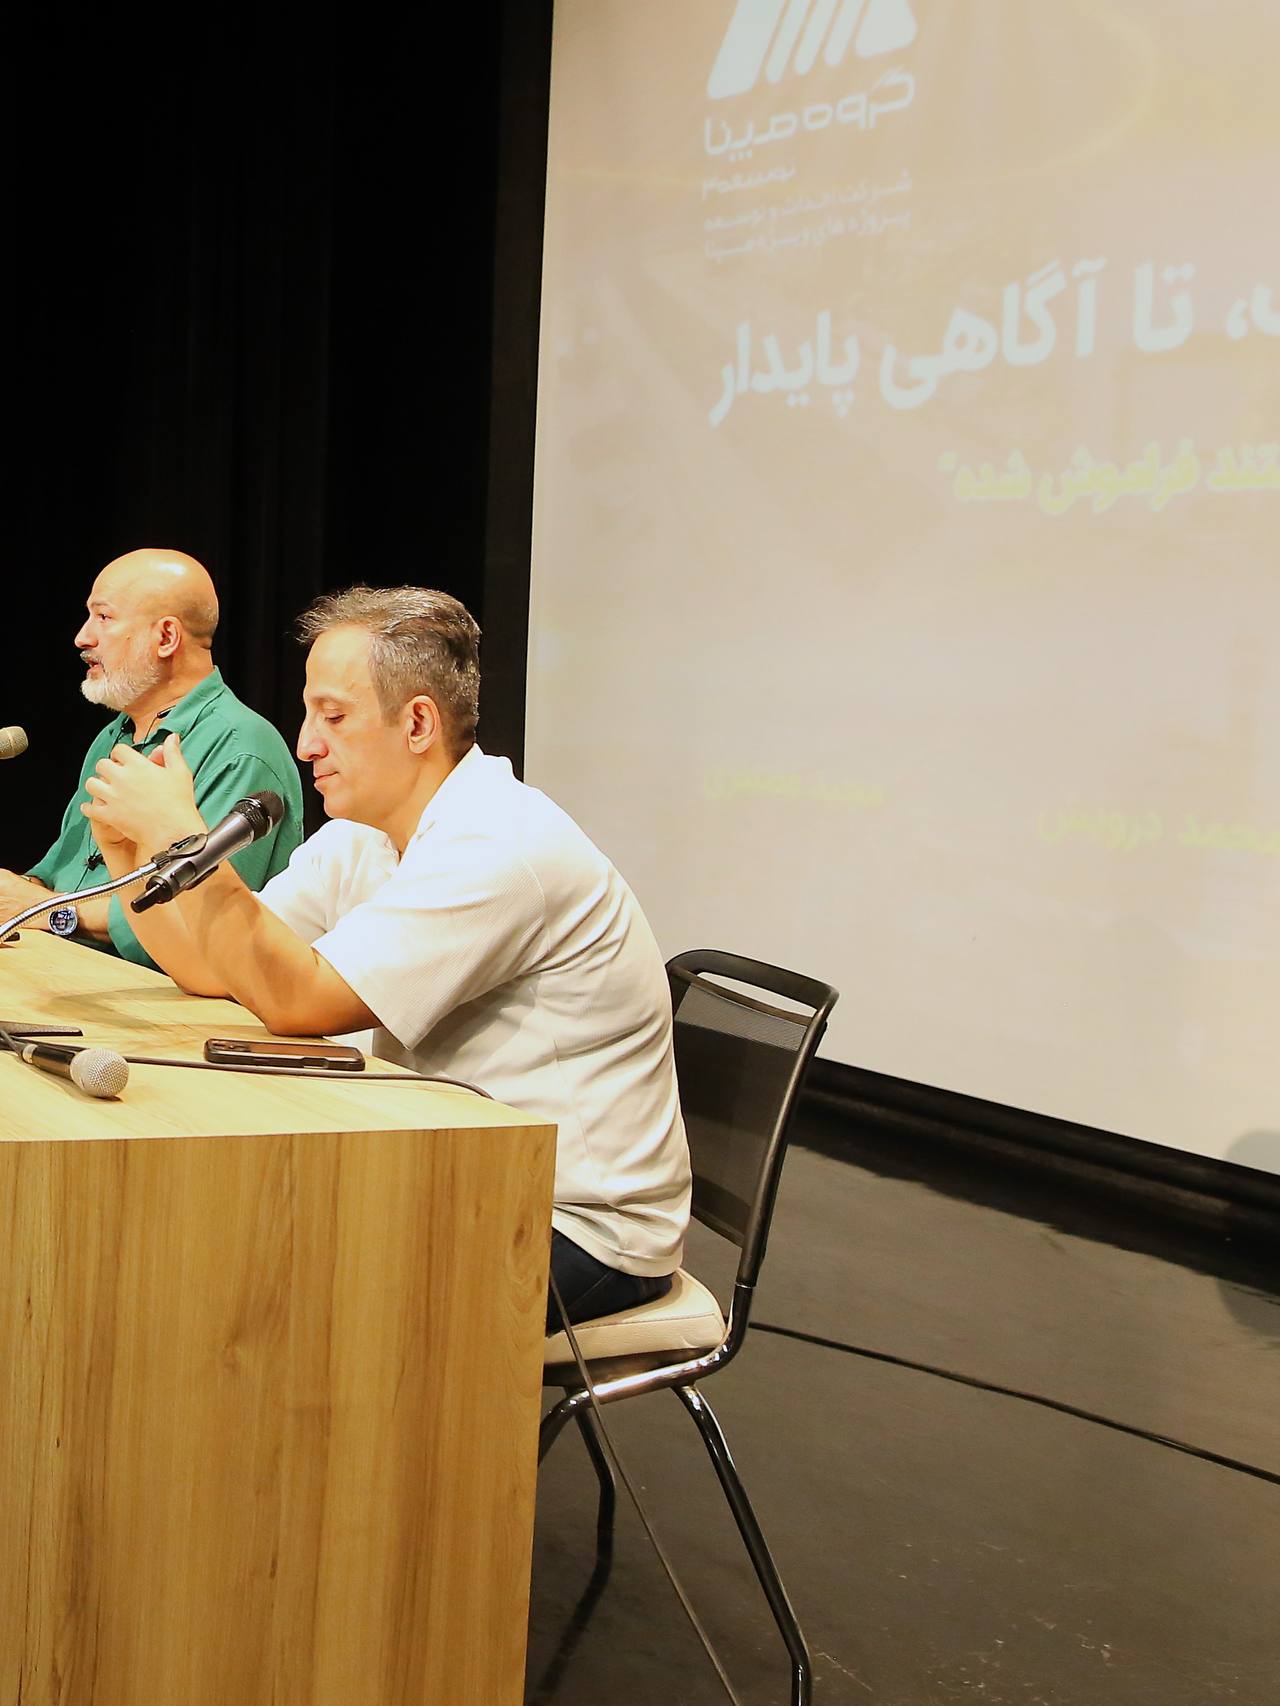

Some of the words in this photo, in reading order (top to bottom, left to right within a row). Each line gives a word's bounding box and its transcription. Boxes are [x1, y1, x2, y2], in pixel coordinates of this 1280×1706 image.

[879, 256, 1108, 411] آگاهی
[1132, 260, 1196, 352] تا
[707, 309, 861, 428] پایدار
